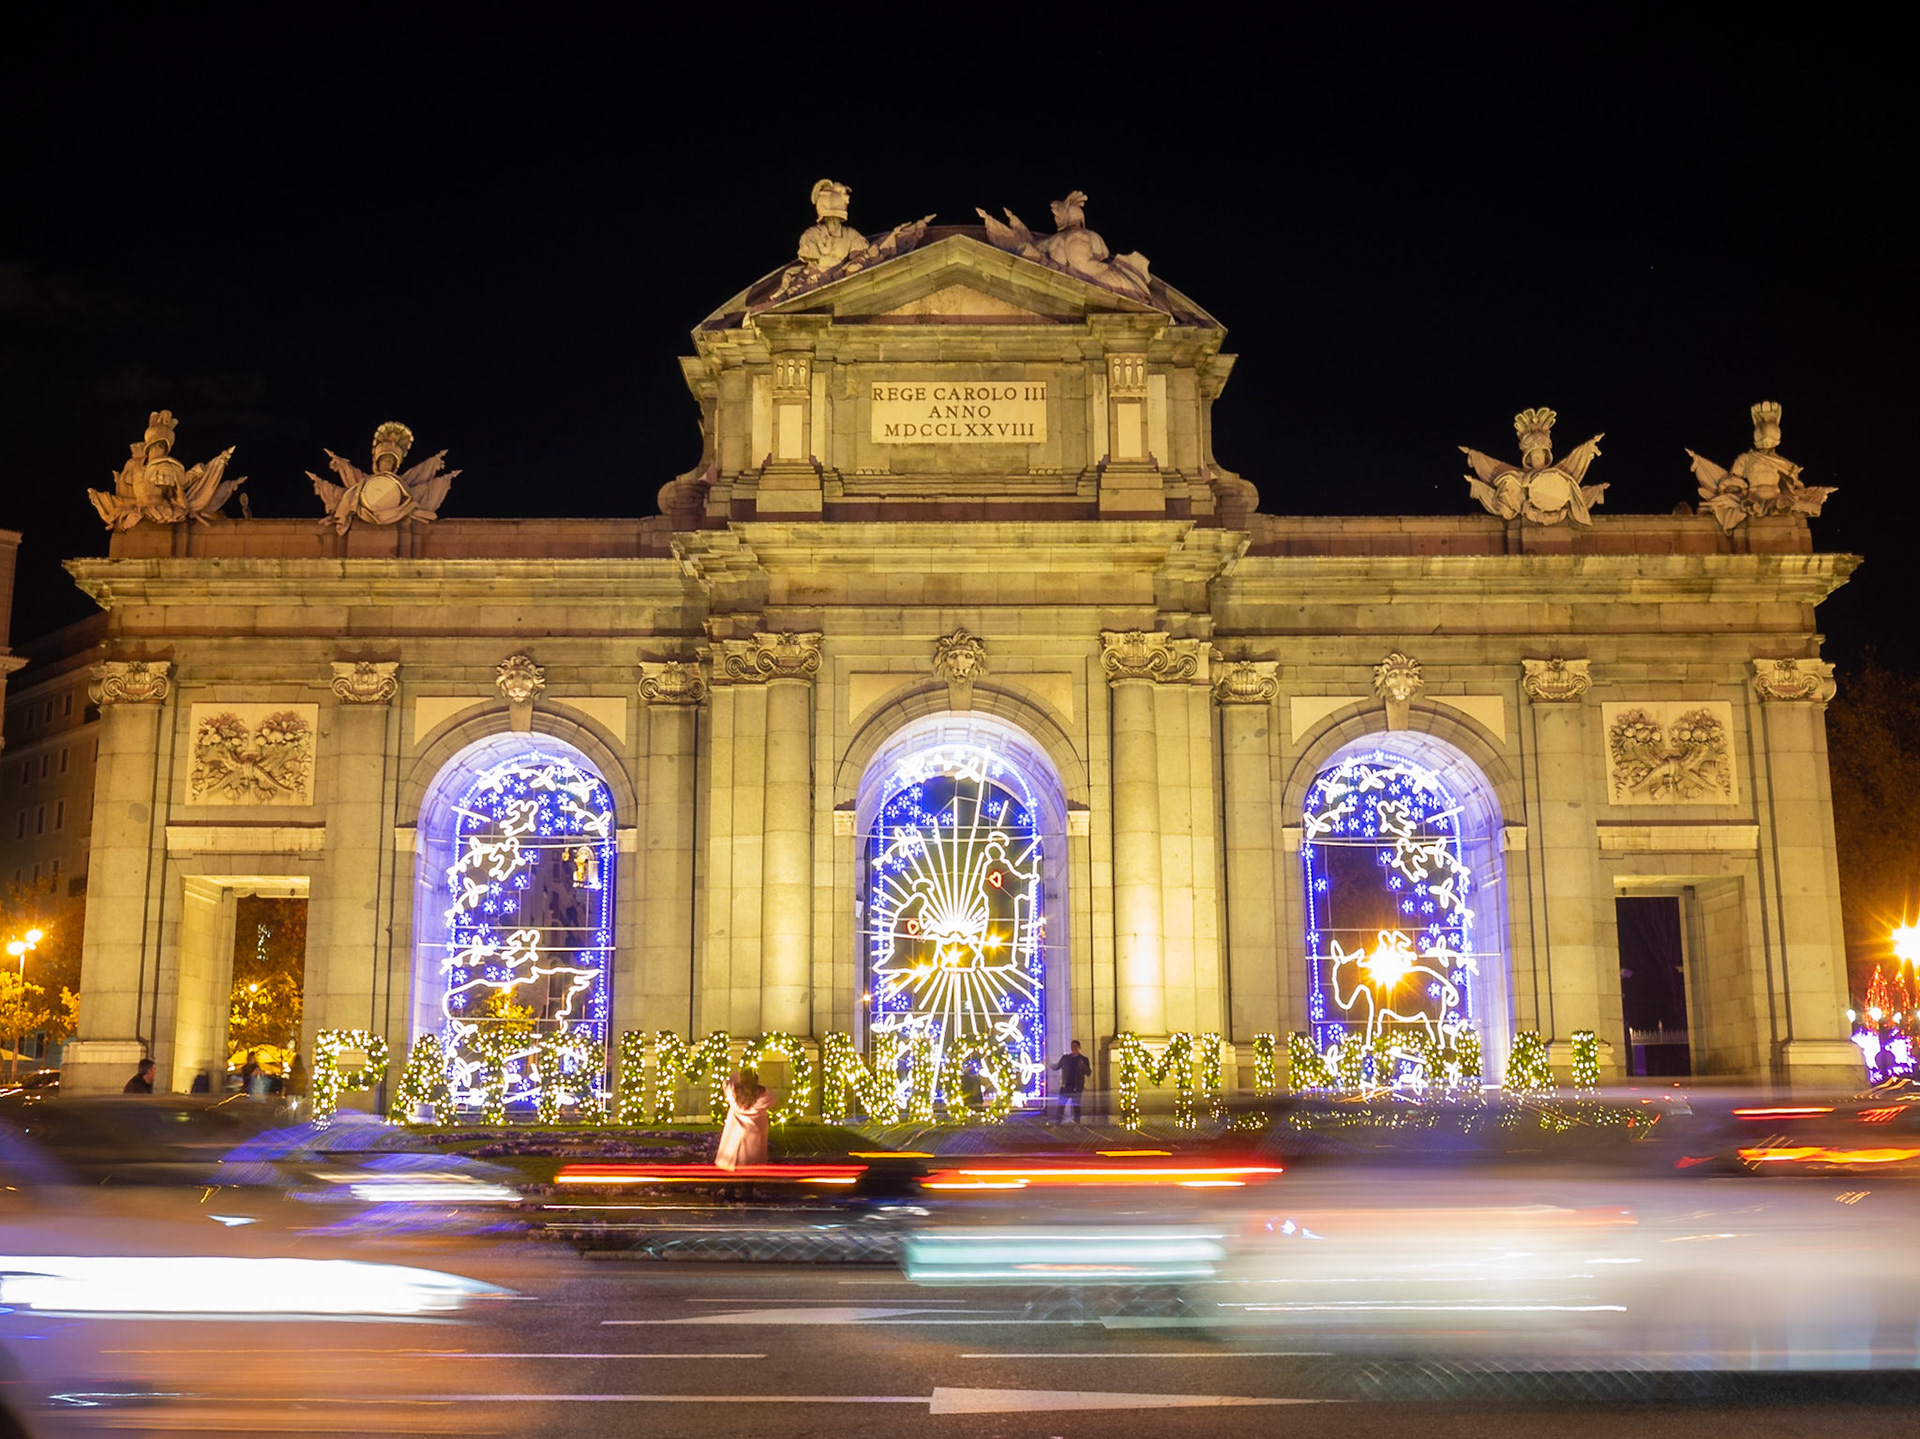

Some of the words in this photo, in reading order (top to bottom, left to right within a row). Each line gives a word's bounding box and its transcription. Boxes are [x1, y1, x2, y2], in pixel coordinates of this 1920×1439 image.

[872, 387, 926, 401] REGE
[933, 387, 1017, 401] CAROLO
[1024, 387, 1047, 401] III
[928, 405, 991, 418] ANNO
[885, 423, 1035, 437] MDCCLXXVIII
[311, 1028, 1017, 1131] PATRIMONIO
